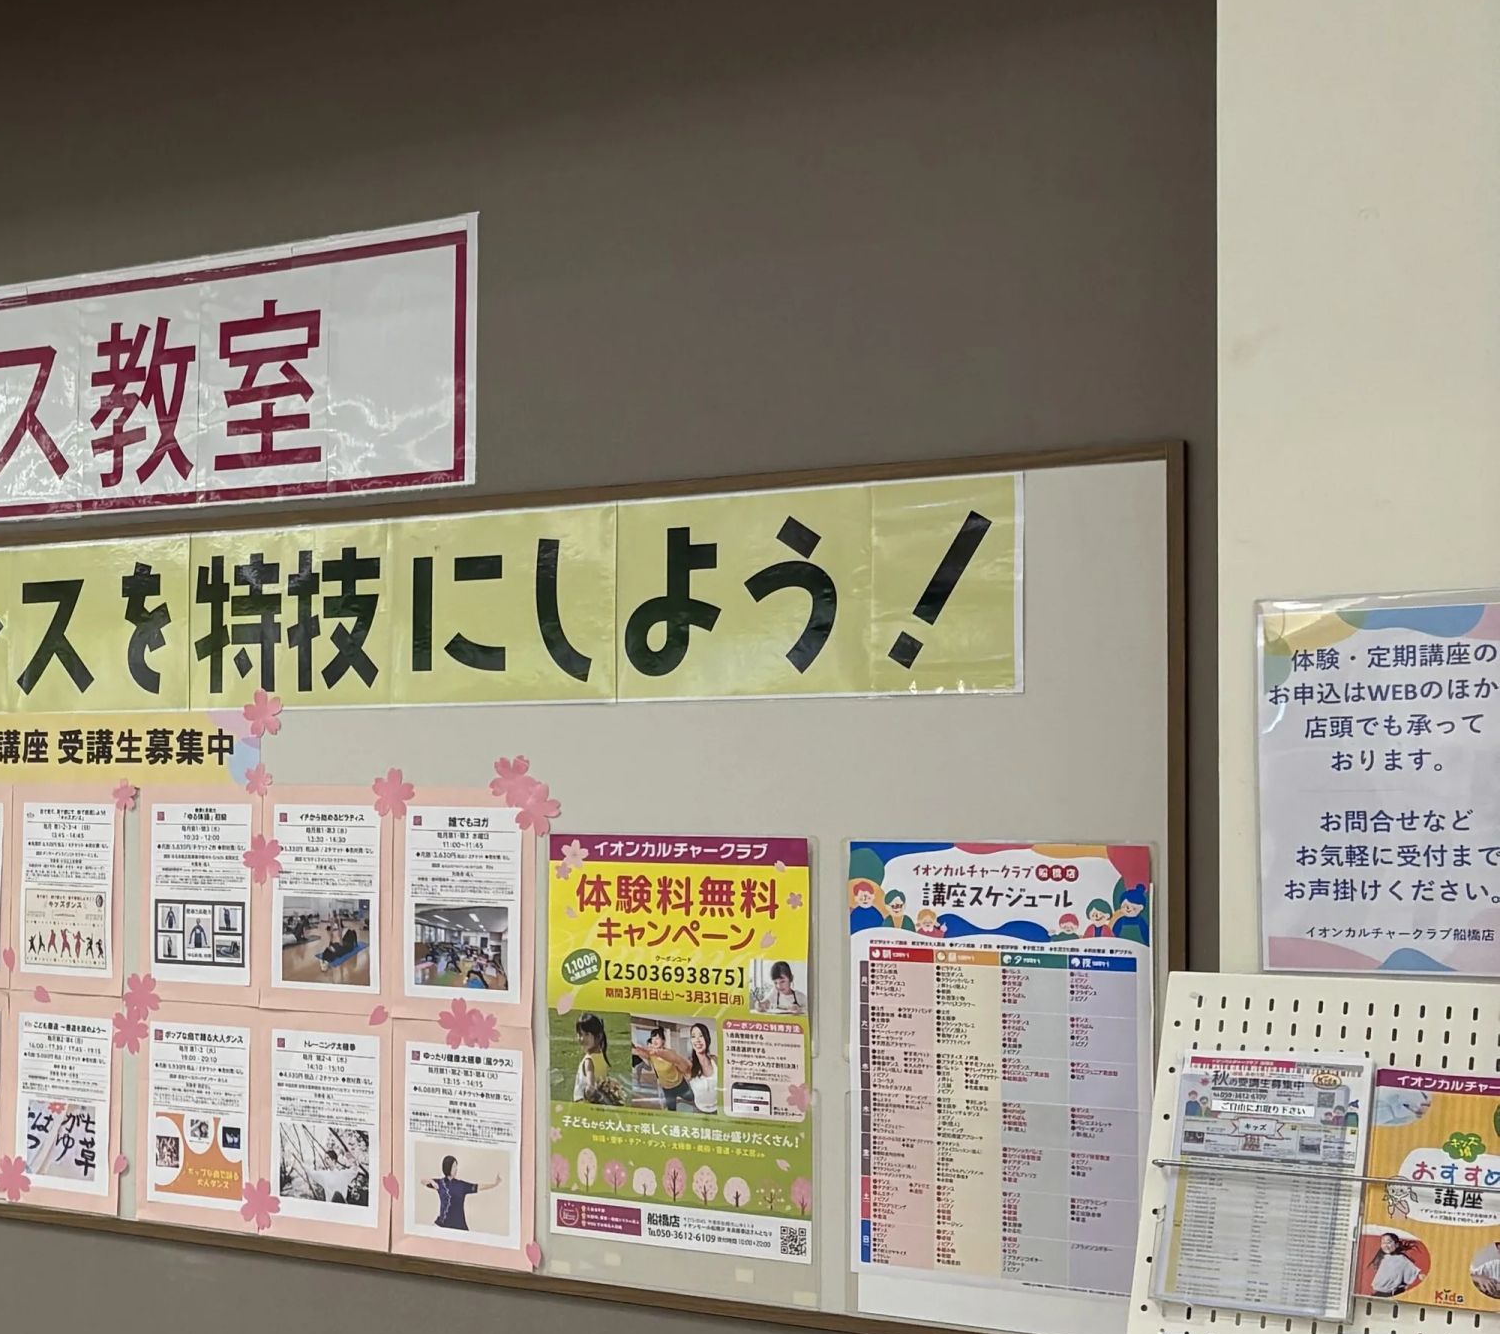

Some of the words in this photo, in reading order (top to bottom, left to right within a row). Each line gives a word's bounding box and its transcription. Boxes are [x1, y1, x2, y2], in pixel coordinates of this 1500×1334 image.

[1291, 643, 1498, 672] 体験・定期講座の
[1268, 678, 1499, 706] お申込はWEBのほか
[1304, 713, 1484, 739] 店頭でも承って
[58, 727, 236, 766] 受講生募集中
[1331, 749, 1443, 772] おります。
[448, 817, 489, 828] 誰でもヨガ
[1320, 809, 1473, 833] お問合せなど
[595, 842, 768, 860] イオンカルチャークラブ
[1295, 844, 1500, 867] お気軽に受付まで
[912, 864, 1034, 879] イオンカルチャークラブ
[576, 874, 779, 920] 体験料無料
[922, 882, 1073, 909] 講座スケジュール
[1284, 878, 1500, 905] お声掛けください。
[597, 918, 755, 951] キャンペーン
[1305, 926, 1495, 942] イオンカルチャークラブ船橋店
[604, 961, 744, 988] 【2503693875】
[726, 1021, 800, 1033] クーポンのご利用方法
[1211, 1070, 1305, 1090] 秋の受講生募集中
[1317, 1076, 1337, 1085] Kids
[1396, 1075, 1500, 1094] イオンカルチャー
[1221, 1102, 1306, 1115] ご自由にお取り下さい
[1244, 1123, 1267, 1131] キッズ
[1450, 1136, 1478, 1149] キッズ
[1434, 1189, 1483, 1210] 講座
[647, 1212, 680, 1228] 船橋店
[1435, 1291, 1464, 1303] Kids
